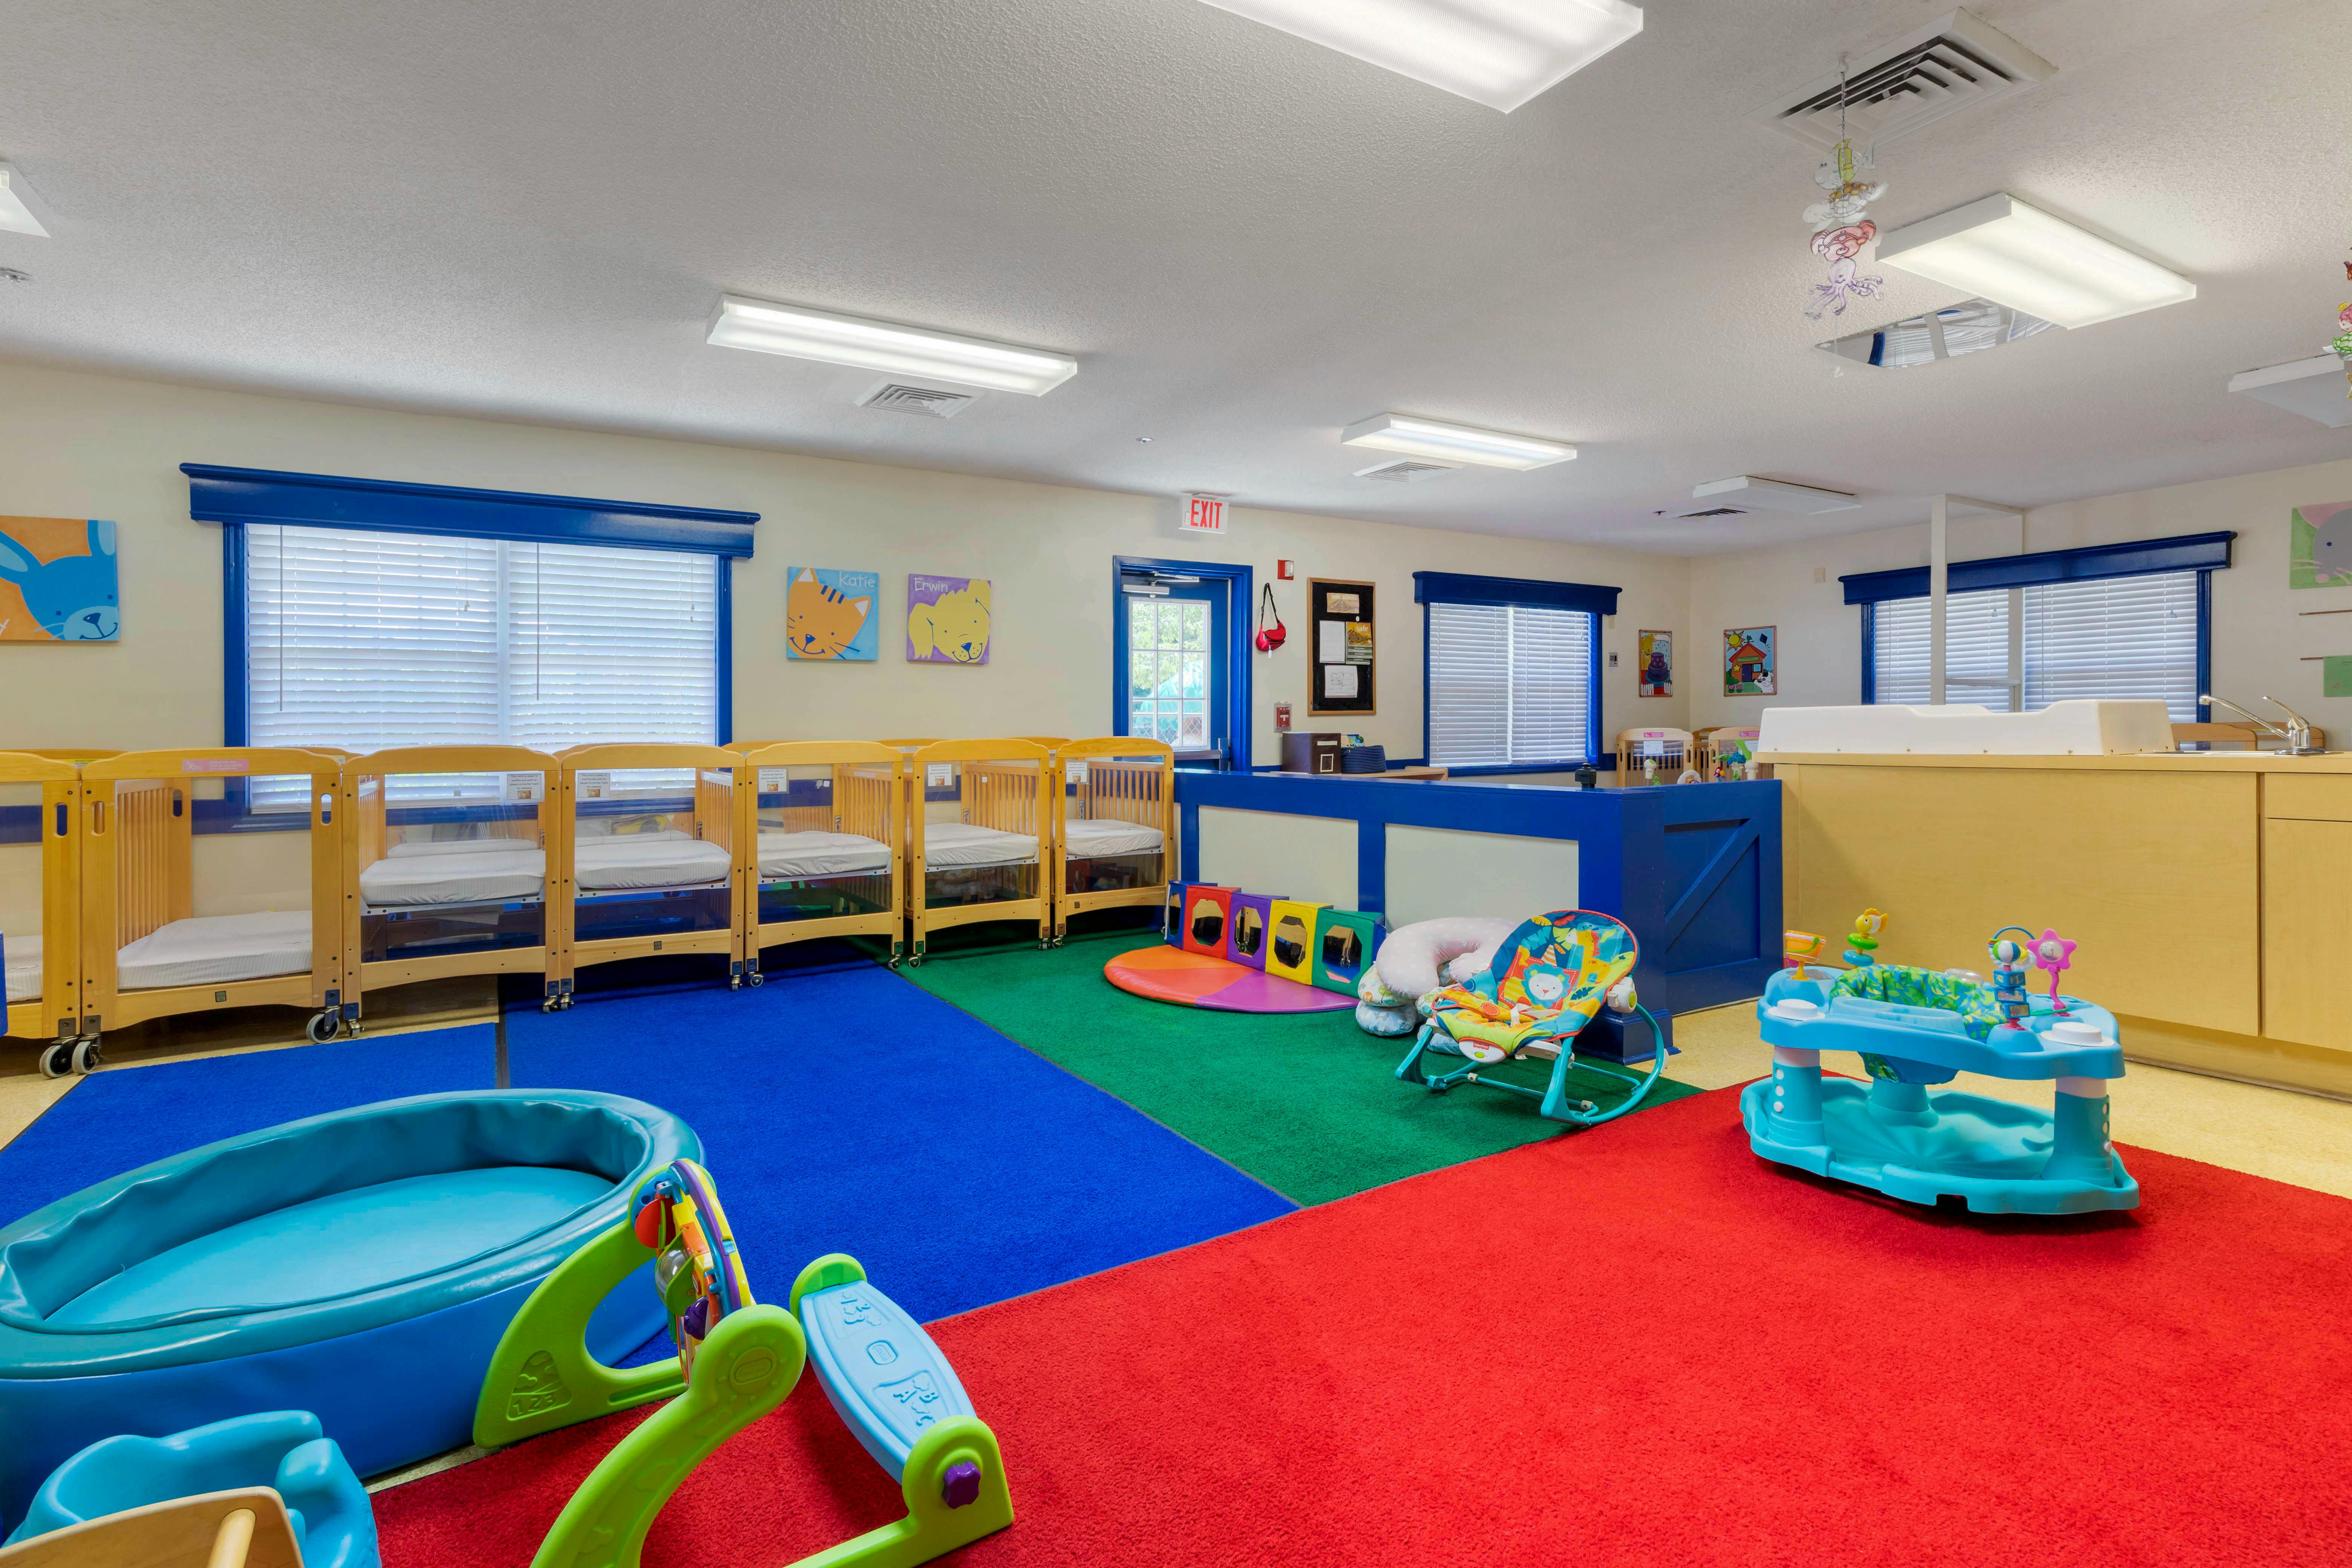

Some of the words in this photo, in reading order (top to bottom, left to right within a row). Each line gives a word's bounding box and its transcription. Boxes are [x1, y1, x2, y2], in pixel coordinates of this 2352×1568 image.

[1190, 499, 1223, 529] EXIT
[839, 571, 876, 588] Katie
[914, 577, 948, 592] Erwin
[513, 1399, 523, 1415] 1
[528, 1395, 541, 1412] 2
